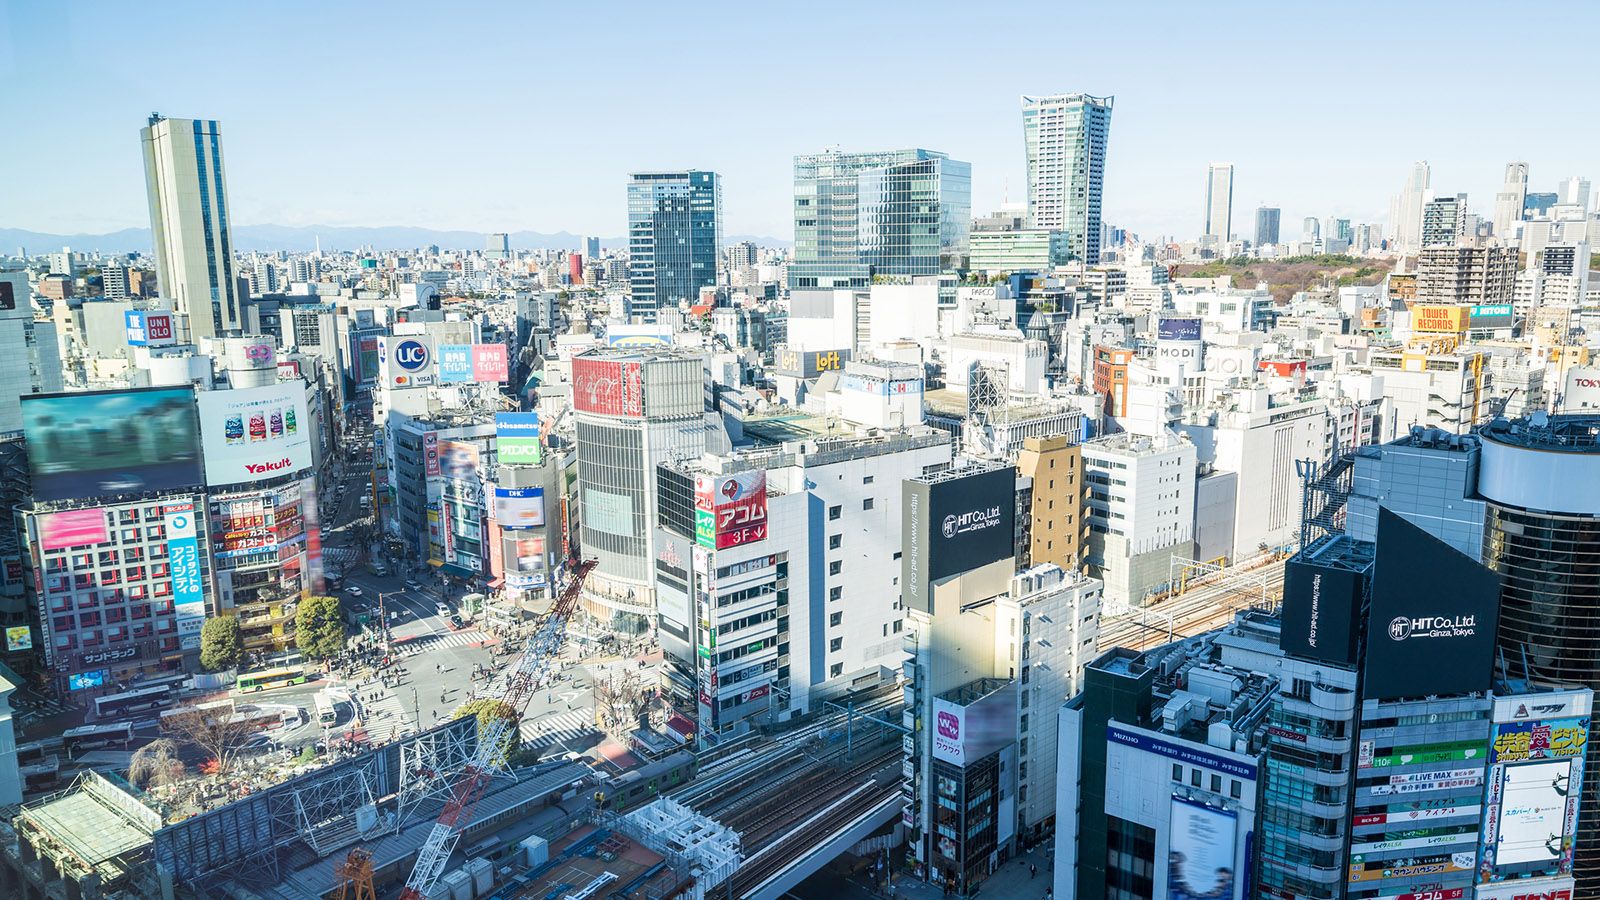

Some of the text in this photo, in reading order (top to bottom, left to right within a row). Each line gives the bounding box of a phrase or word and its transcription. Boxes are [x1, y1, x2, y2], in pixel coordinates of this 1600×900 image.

[971, 288, 995, 297] PARCO
[1421, 308, 1449, 319] TOWER
[149, 319, 167, 328] UNI
[1418, 319, 1453, 330] RECORDS
[150, 327, 169, 338] QLO
[398, 347, 425, 363] UC
[1160, 347, 1195, 358] MODI
[499, 444, 537, 456] サロンパス
[245, 457, 292, 474] Yakult
[694, 495, 713, 508] アコム
[719, 503, 765, 529] アコム
[957, 512, 974, 526] HIT
[237, 537, 262, 547] ガスト
[732, 528, 751, 544] 3F
[910, 493, 919, 597] https://www.hit-ad.co.jp/
[171, 546, 188, 595] アイシティ
[185, 545, 200, 592] コンタクトの
[1308, 573, 1322, 648] https://www.hit-ad.co.jp/
[1411, 617, 1435, 630] HIT
[1429, 628, 1475, 638] Ginza, Tokyo.
[84, 647, 136, 664] サンドラッグ
[1113, 731, 1139, 744] MIZUHO
[935, 741, 961, 756] ワクワク
[1552, 748, 1583, 757] VISION
[1433, 771, 1452, 780] MAX
[1426, 799, 1456, 807] アイフル
[1425, 808, 1455, 817] アイフル
[1428, 836, 1457, 844] レイクALSA
[1393, 865, 1445, 876] タウンハウジング
[1420, 881, 1443, 893] アコム
[1451, 890, 1462, 898] 5F
